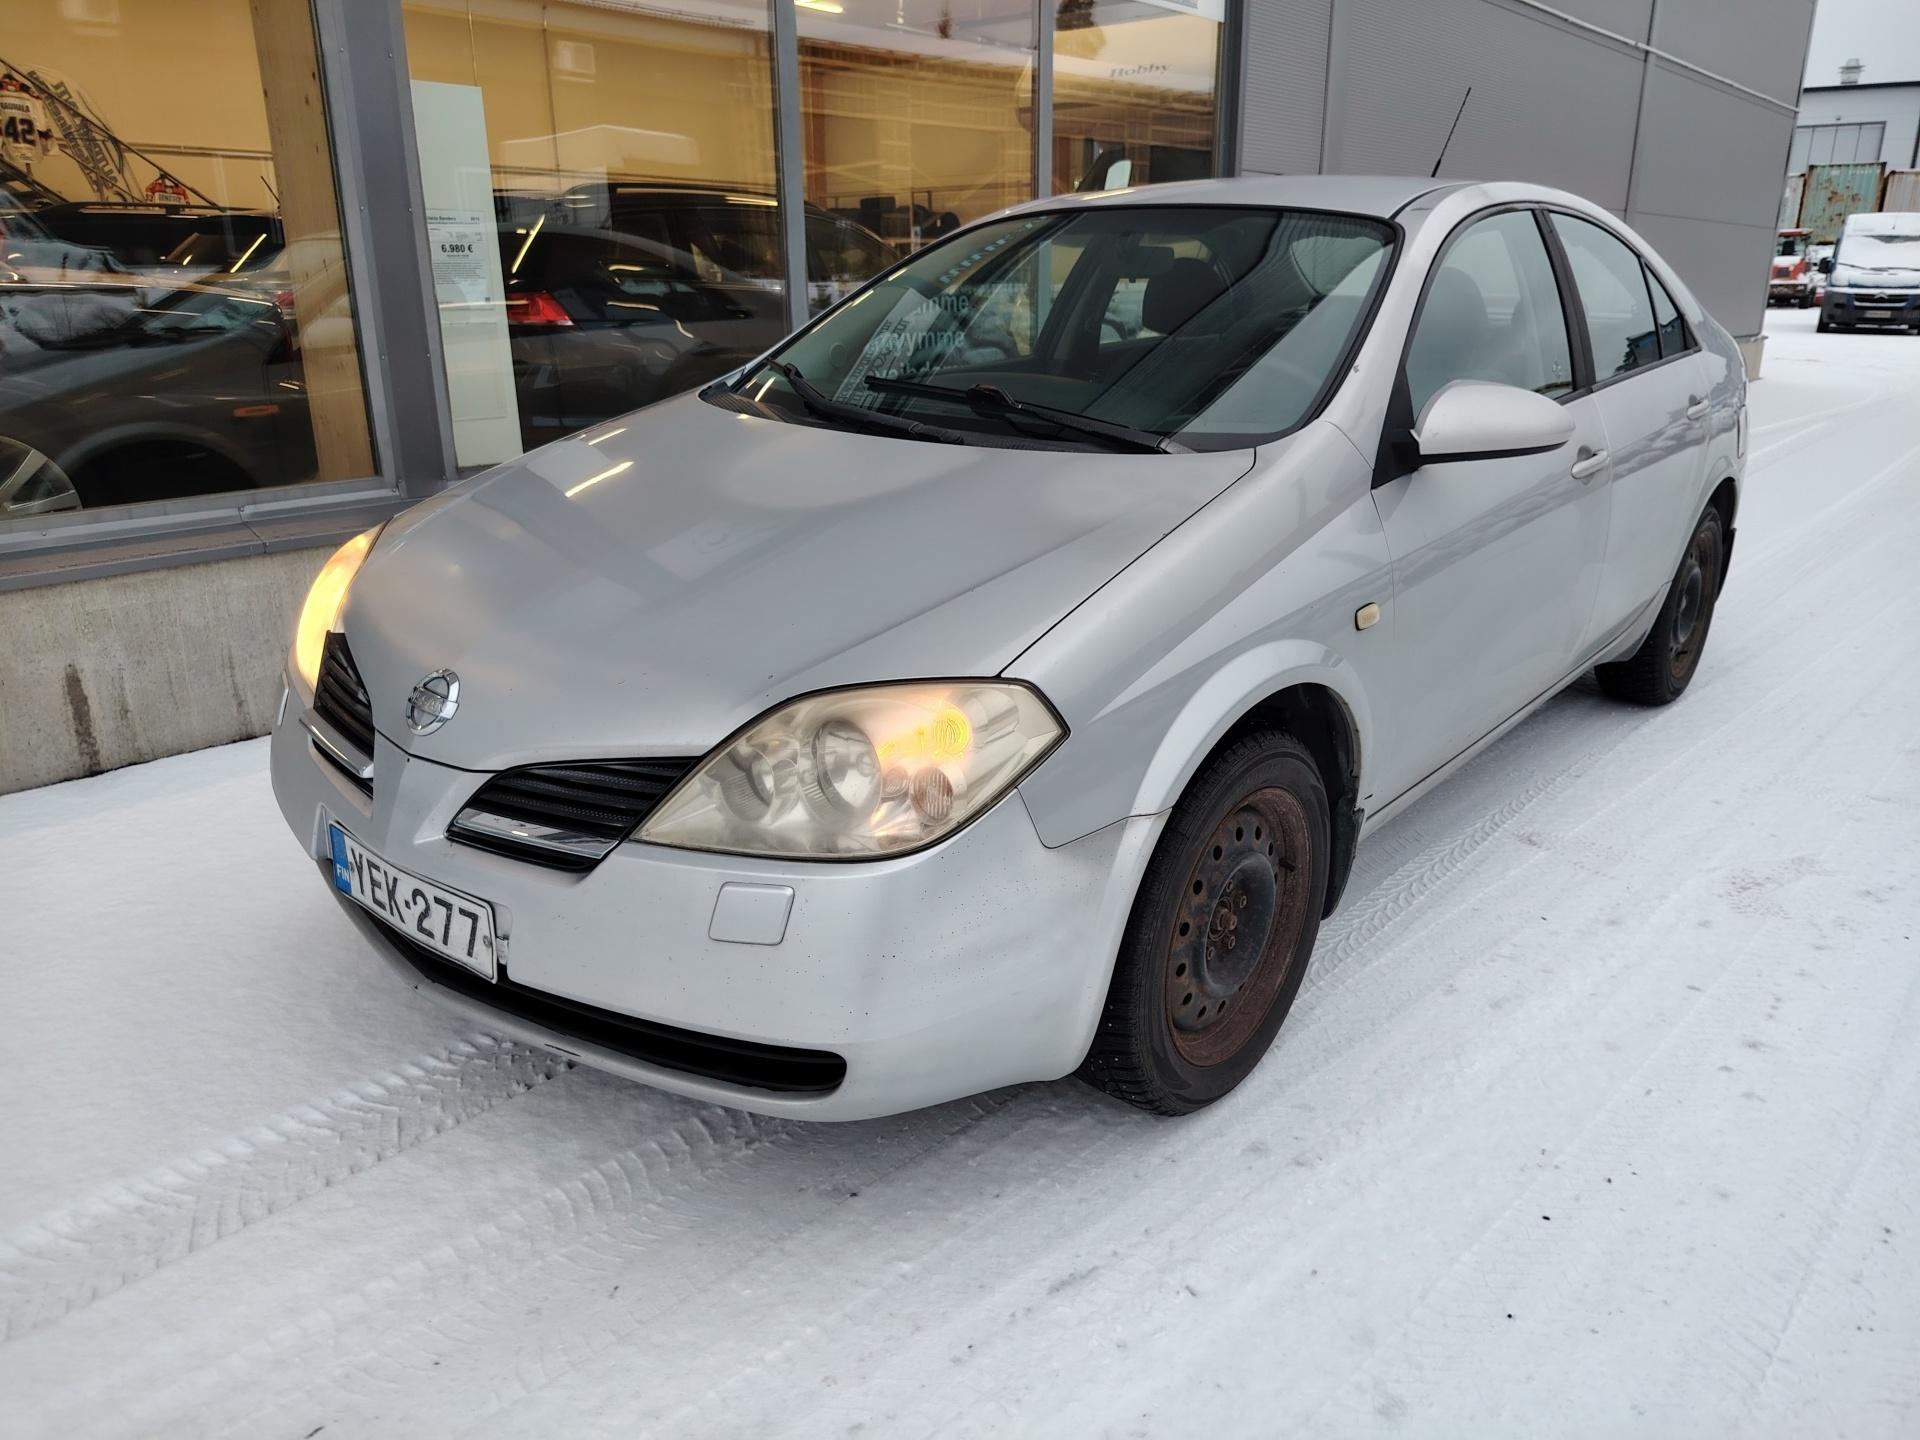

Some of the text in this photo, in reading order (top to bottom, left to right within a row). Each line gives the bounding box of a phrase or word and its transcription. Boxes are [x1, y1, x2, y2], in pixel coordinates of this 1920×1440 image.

[1110, 64, 1168, 77] Hobby
[4, 116, 36, 146] 42
[336, 864, 350, 883] FIN
[350, 847, 479, 958] YEK-277
